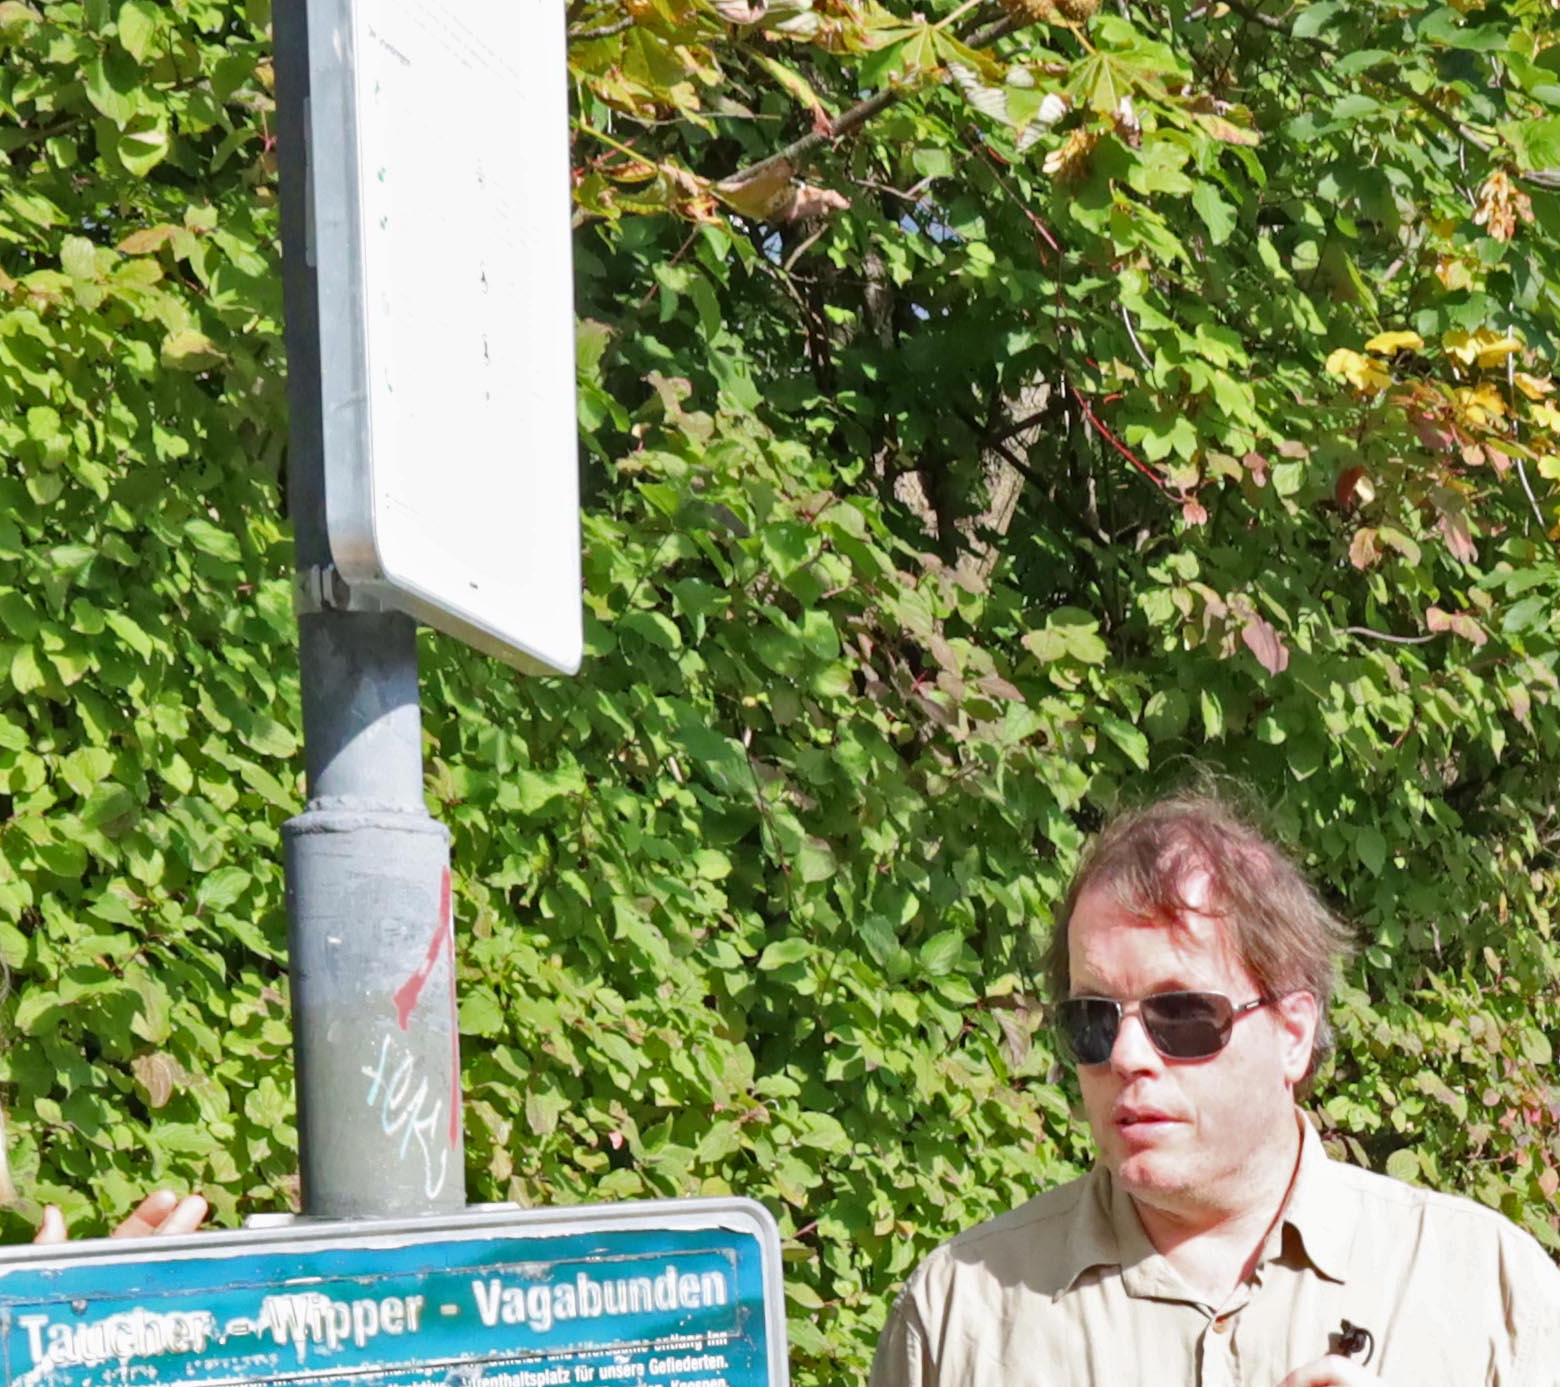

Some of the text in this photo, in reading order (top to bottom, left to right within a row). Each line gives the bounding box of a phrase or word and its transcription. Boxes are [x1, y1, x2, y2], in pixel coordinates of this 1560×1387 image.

[18, 1307, 212, 1365] Taucher
[265, 1294, 424, 1350] Wipper
[472, 1265, 728, 1333] Vagabunden
[575, 1364, 595, 1383] für
[599, 1362, 645, 1380] unsere
[648, 1354, 729, 1376] Gefiederten.
